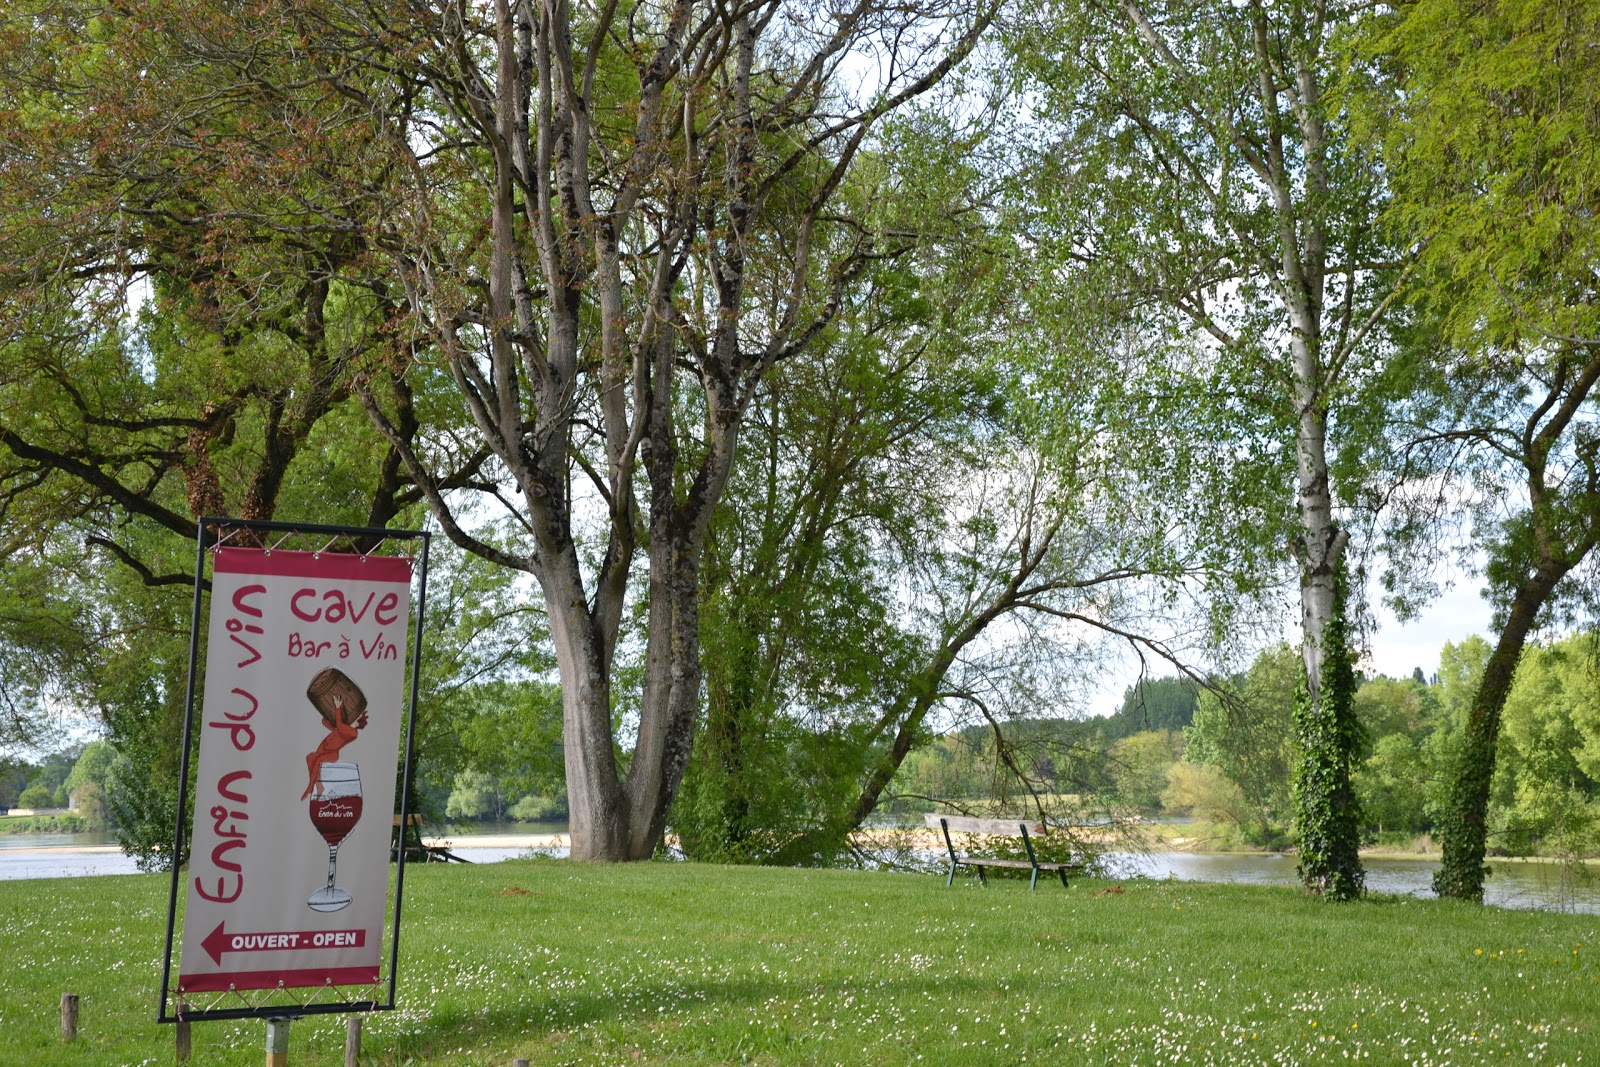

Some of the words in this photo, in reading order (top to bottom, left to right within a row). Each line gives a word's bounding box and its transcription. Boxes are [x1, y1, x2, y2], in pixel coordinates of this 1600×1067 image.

[225, 584, 267, 668] vin
[288, 632, 332, 658] Bar
[339, 634, 351, 659] à
[359, 632, 397, 660] Vin
[208, 688, 259, 751] du
[194, 770, 253, 903] Enfin
[231, 934, 300, 950] OUVERT
[313, 932, 356, 946] OPEN
